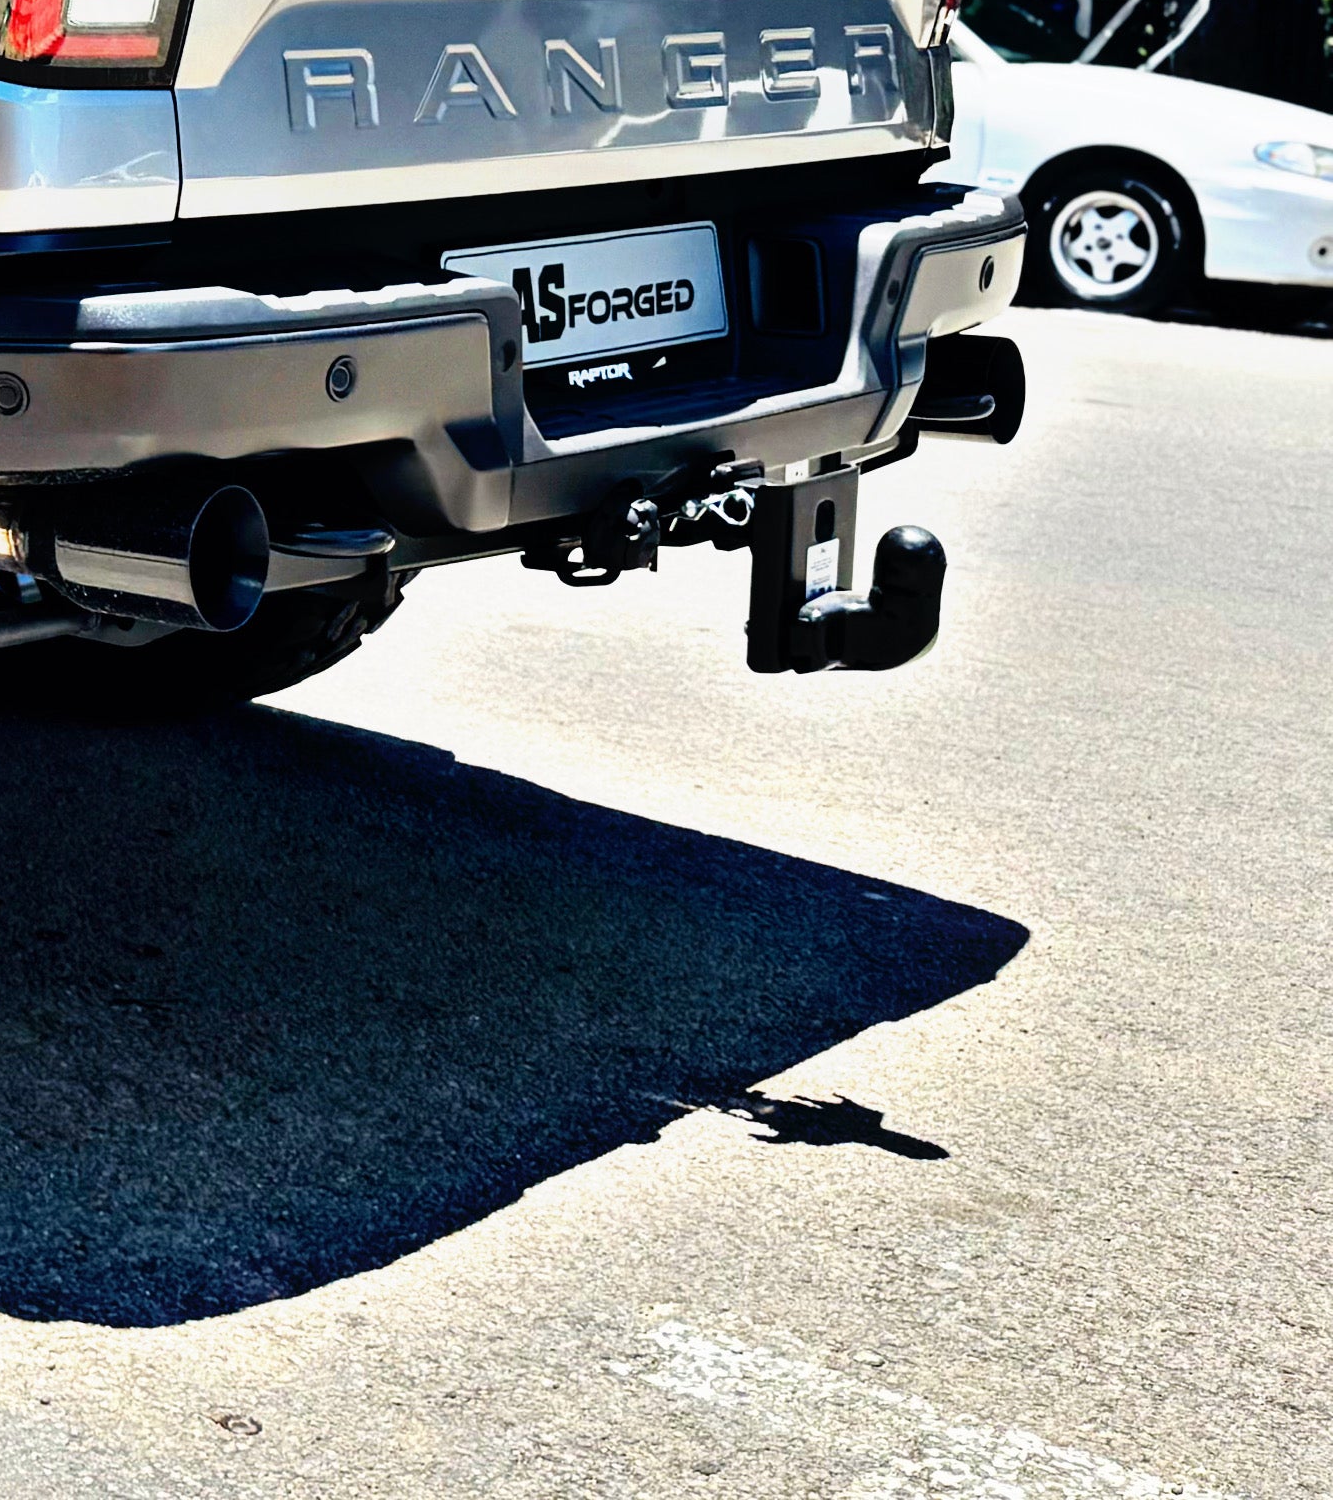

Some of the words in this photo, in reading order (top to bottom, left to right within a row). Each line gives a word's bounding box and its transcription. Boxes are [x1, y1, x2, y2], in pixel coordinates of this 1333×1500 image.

[282, 24, 899, 131] RANGER
[568, 278, 695, 329] FORGED
[568, 362, 633, 389] RAPTOR
